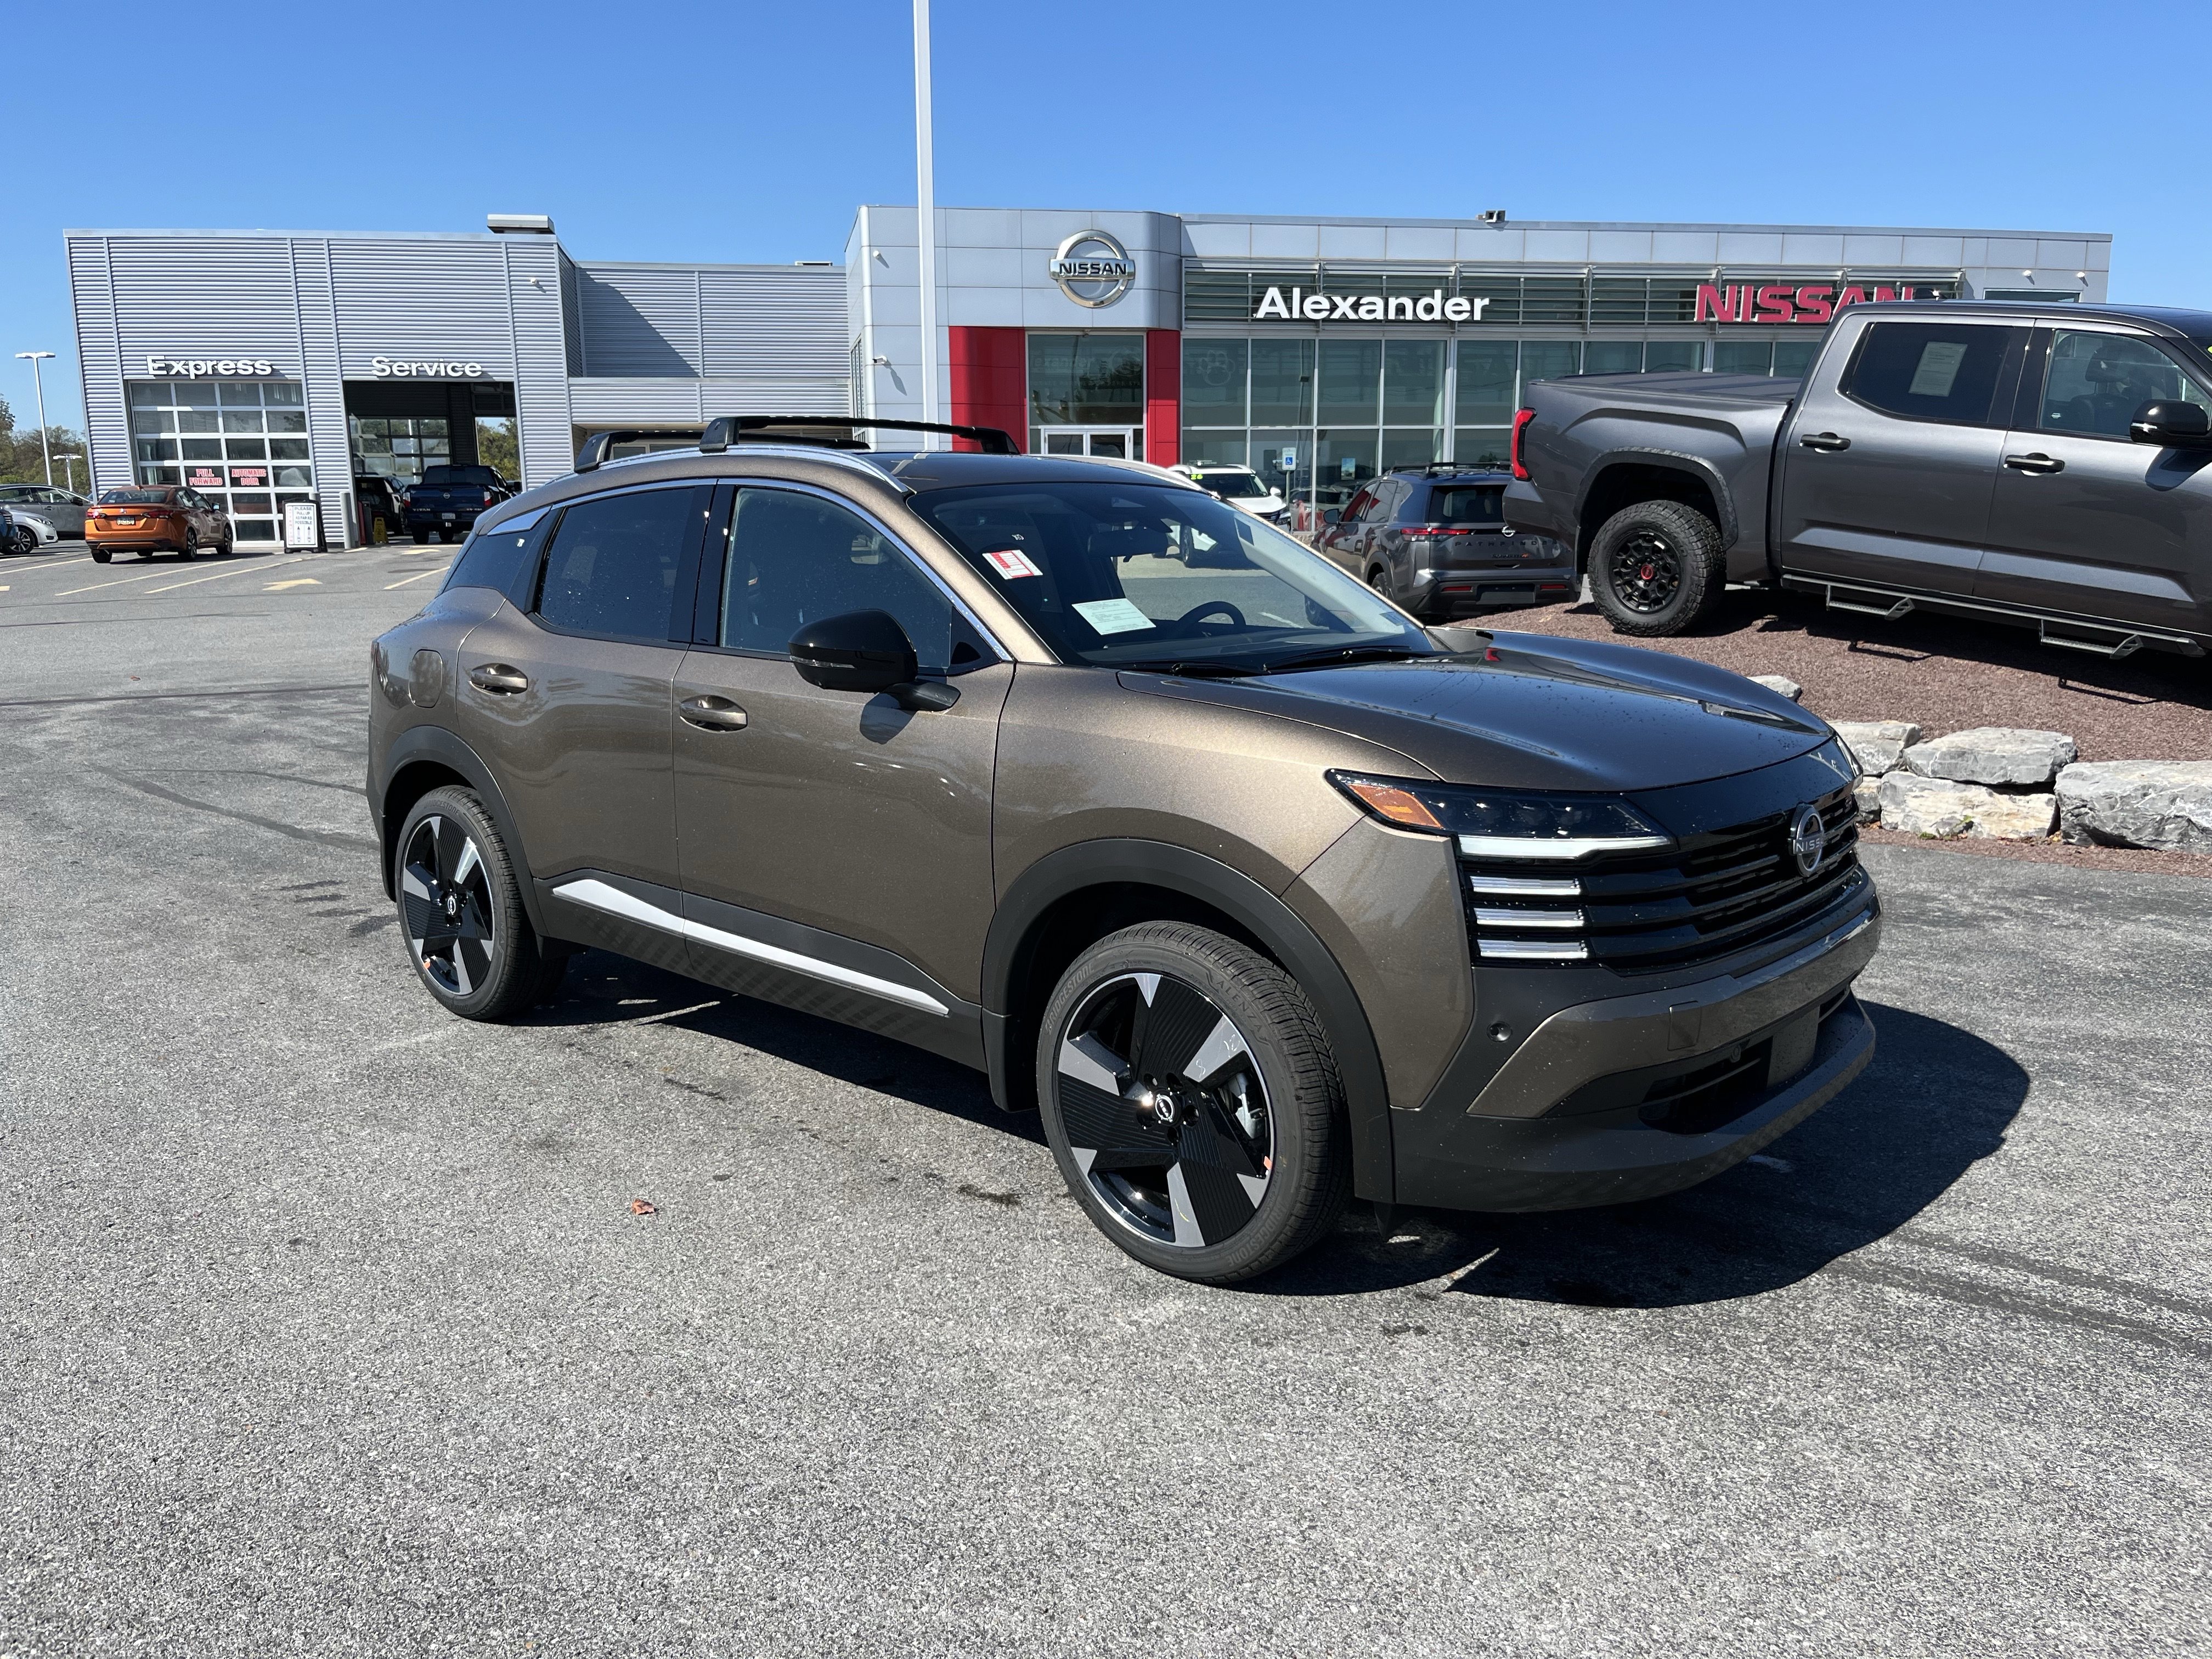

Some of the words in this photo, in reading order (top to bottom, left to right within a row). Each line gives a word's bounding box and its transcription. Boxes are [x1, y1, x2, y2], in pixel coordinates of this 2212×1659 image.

[1059, 262, 1127, 275] NISSAN
[1255, 286, 1489, 321] Alexander
[146, 356, 272, 379] Express
[371, 356, 482, 377] Service
[196, 469, 215, 477] PULL
[232, 469, 267, 477] AUTOMATIC
[189, 477, 223, 486] FORWARD
[240, 477, 259, 486] DOOR
[1796, 838, 1824, 852] NISS
[1045, 961, 1095, 1036] BRIDGESTONE
[1216, 980, 1263, 1032] ALENZA
